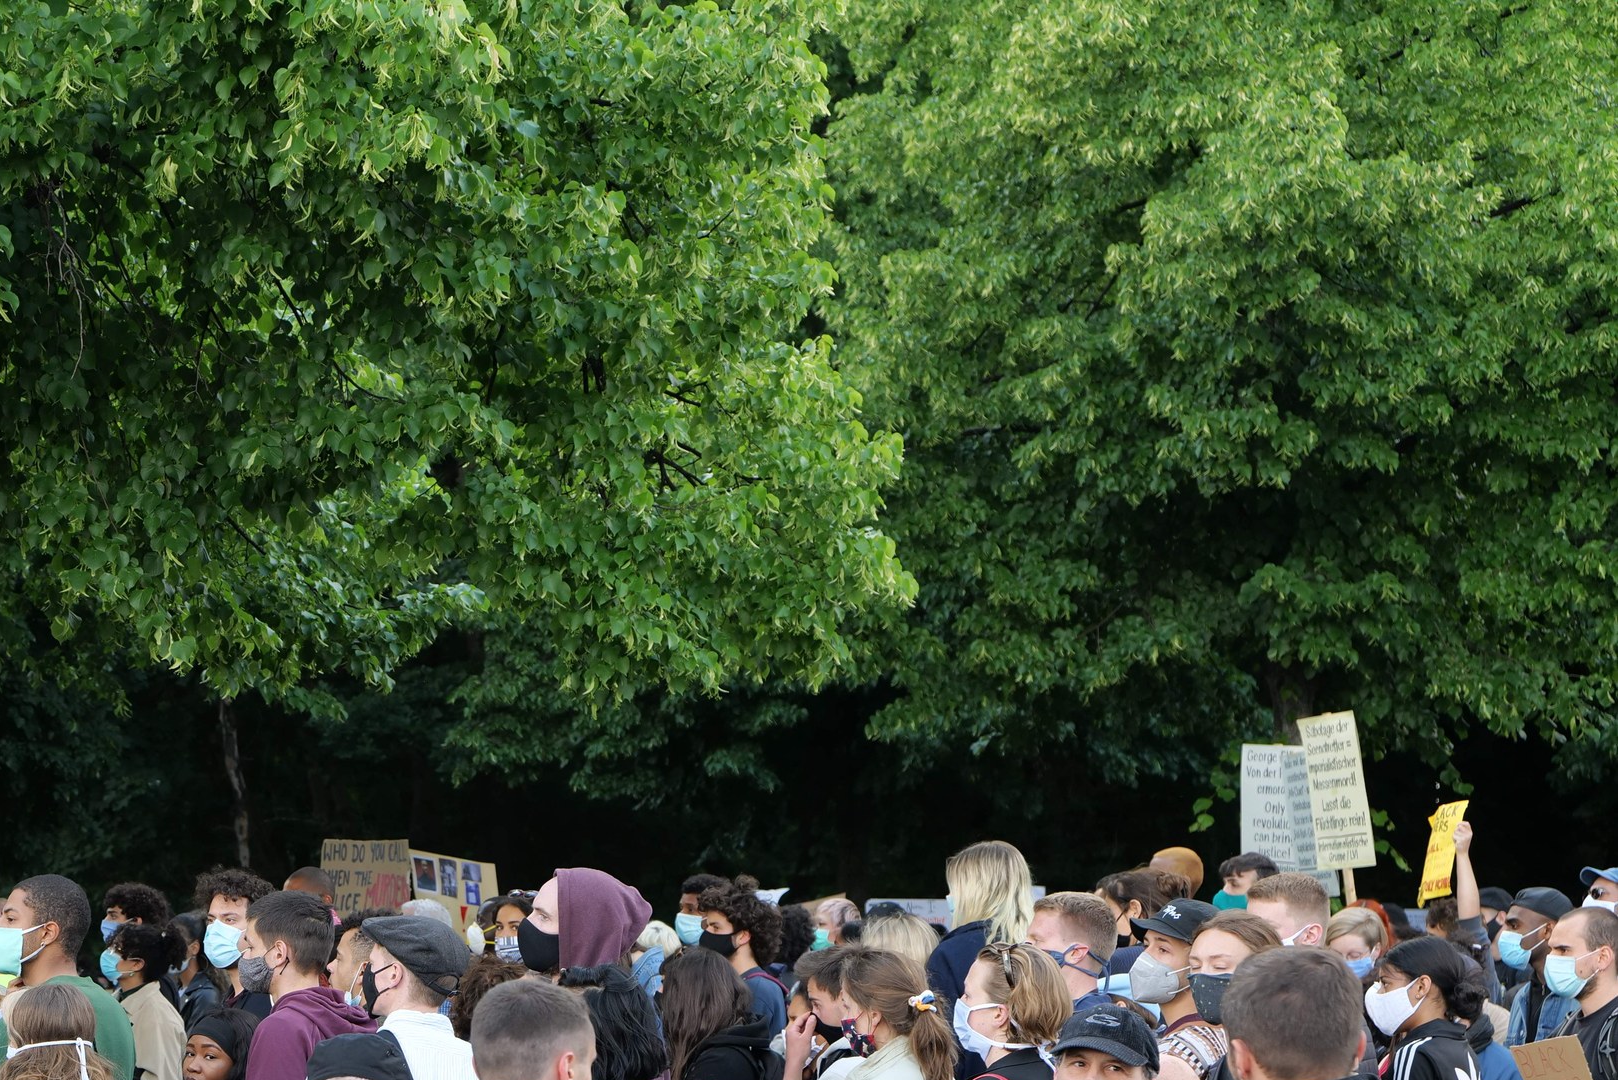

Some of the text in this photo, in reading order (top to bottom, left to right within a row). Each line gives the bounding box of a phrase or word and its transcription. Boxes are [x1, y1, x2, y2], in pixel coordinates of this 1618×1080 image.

[1247, 749, 1278, 763] George
[1246, 766, 1262, 778] Von
[1263, 767, 1277, 779] der
[1264, 800, 1287, 816] Only
[1254, 833, 1271, 843] can
[323, 842, 407, 864] WHO DO YOU CALL
[354, 871, 373, 887] THE
[335, 893, 361, 912] LICE
[1513, 1046, 1574, 1079] BLACK
